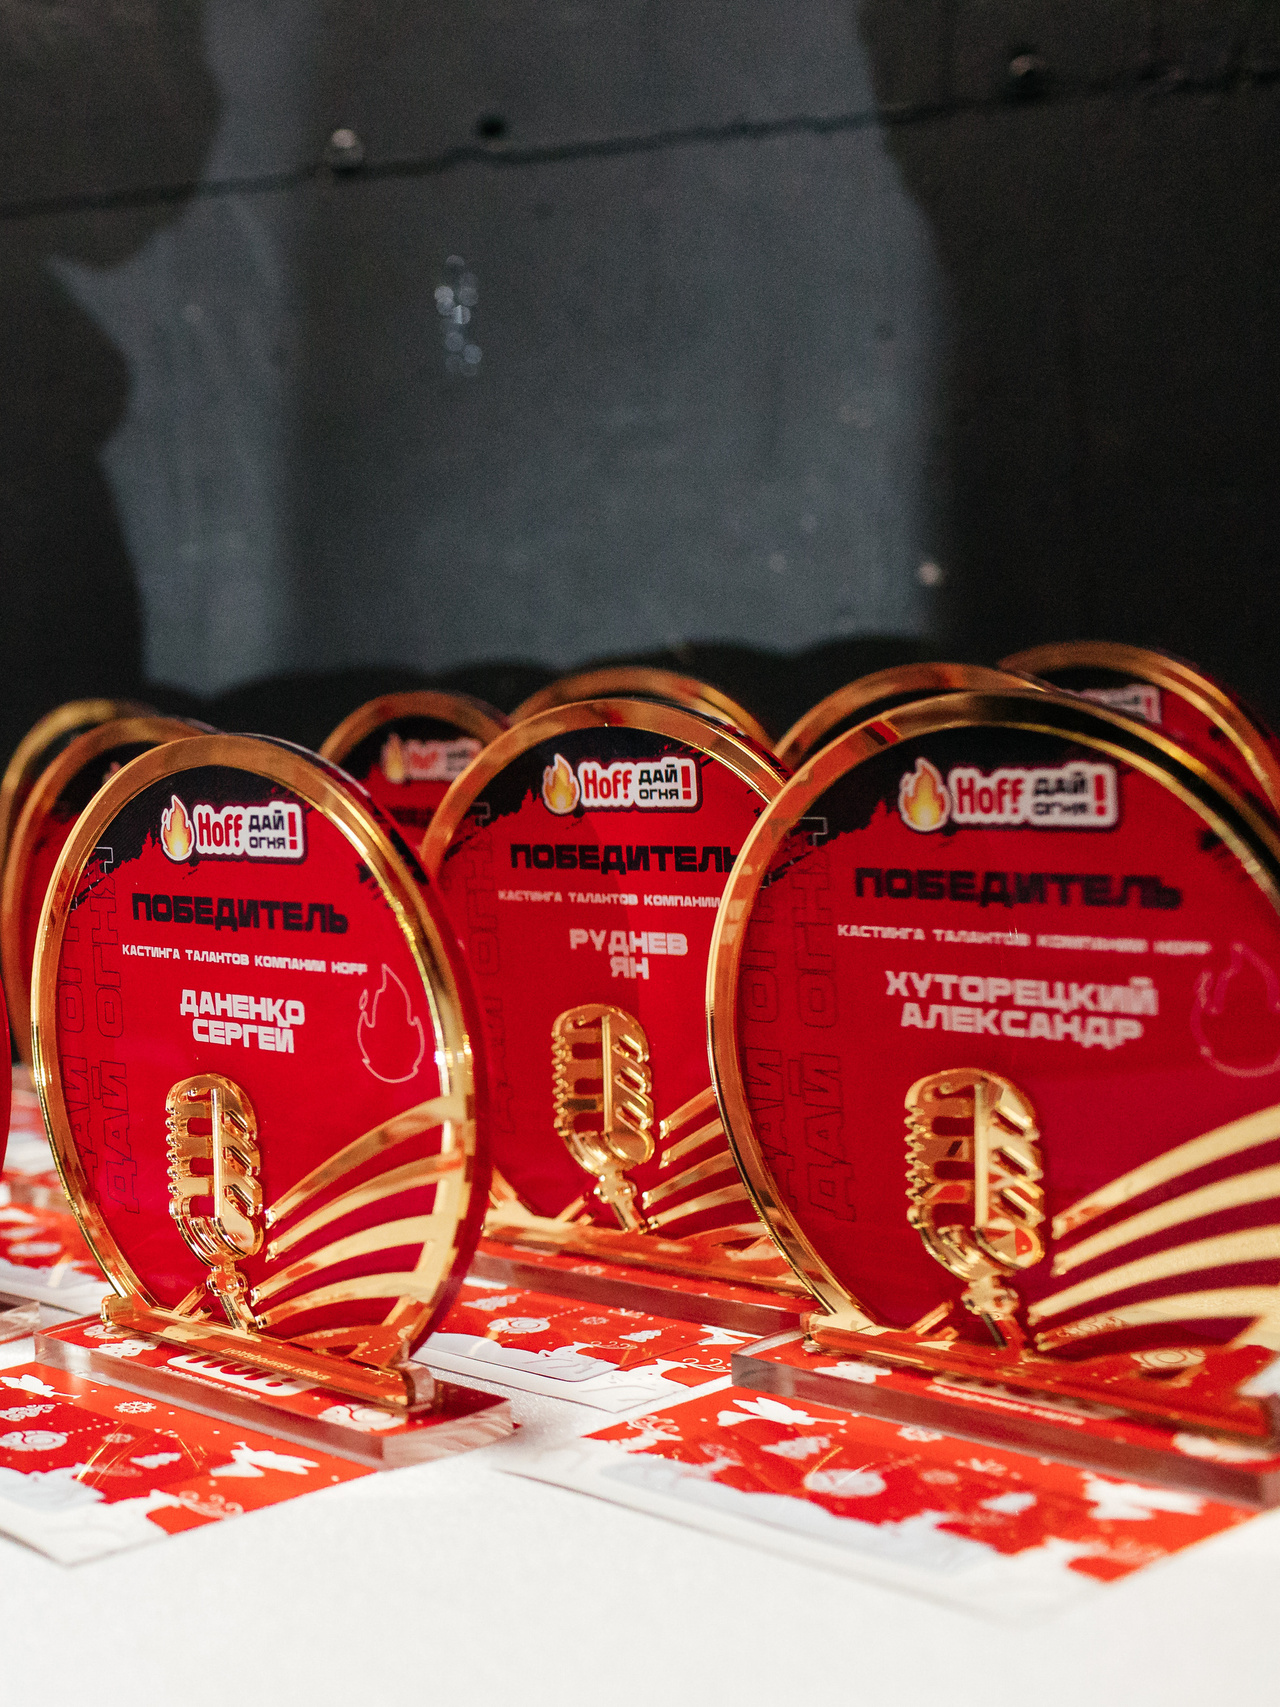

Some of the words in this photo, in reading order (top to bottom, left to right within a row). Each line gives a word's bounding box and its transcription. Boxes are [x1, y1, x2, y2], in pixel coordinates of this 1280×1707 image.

[583, 769, 632, 799] Hoff
[638, 764, 678, 785] ДАЙ
[1034, 771, 1088, 797] ДАЙ
[639, 789, 679, 800] ОГНЯ
[955, 776, 1024, 815] Hoff
[197, 812, 243, 848] Hoff
[249, 810, 284, 832] ДАЙ
[249, 836, 286, 849] ОГНЯ
[498, 890, 563, 902] КАСТИНГА
[568, 892, 638, 906] ТАЛАНТОВ
[855, 867, 1183, 910] ПОБЕДИТЕЛЬ
[132, 893, 349, 934] ПОБЕДИТЕЛЬ
[569, 928, 688, 956] РУДНЕВ
[837, 924, 926, 941] КАСТИНГА
[122, 944, 180, 960] КАСТИНГА
[185, 949, 250, 966] ТАЛАНТОВ
[254, 954, 326, 973] КОМПАНИИ
[609, 956, 650, 980] ЯН
[179, 988, 306, 1026] ДАНЕНКО
[884, 970, 1160, 1017] ХУТОРЕЦКИЙ
[192, 1018, 295, 1054] СЕРГЕЙ
[901, 1002, 1144, 1050] АЛЕКСАНДР
[91, 1060, 140, 1214] ДАЙ
[788, 1052, 856, 1222] ДАЙ
